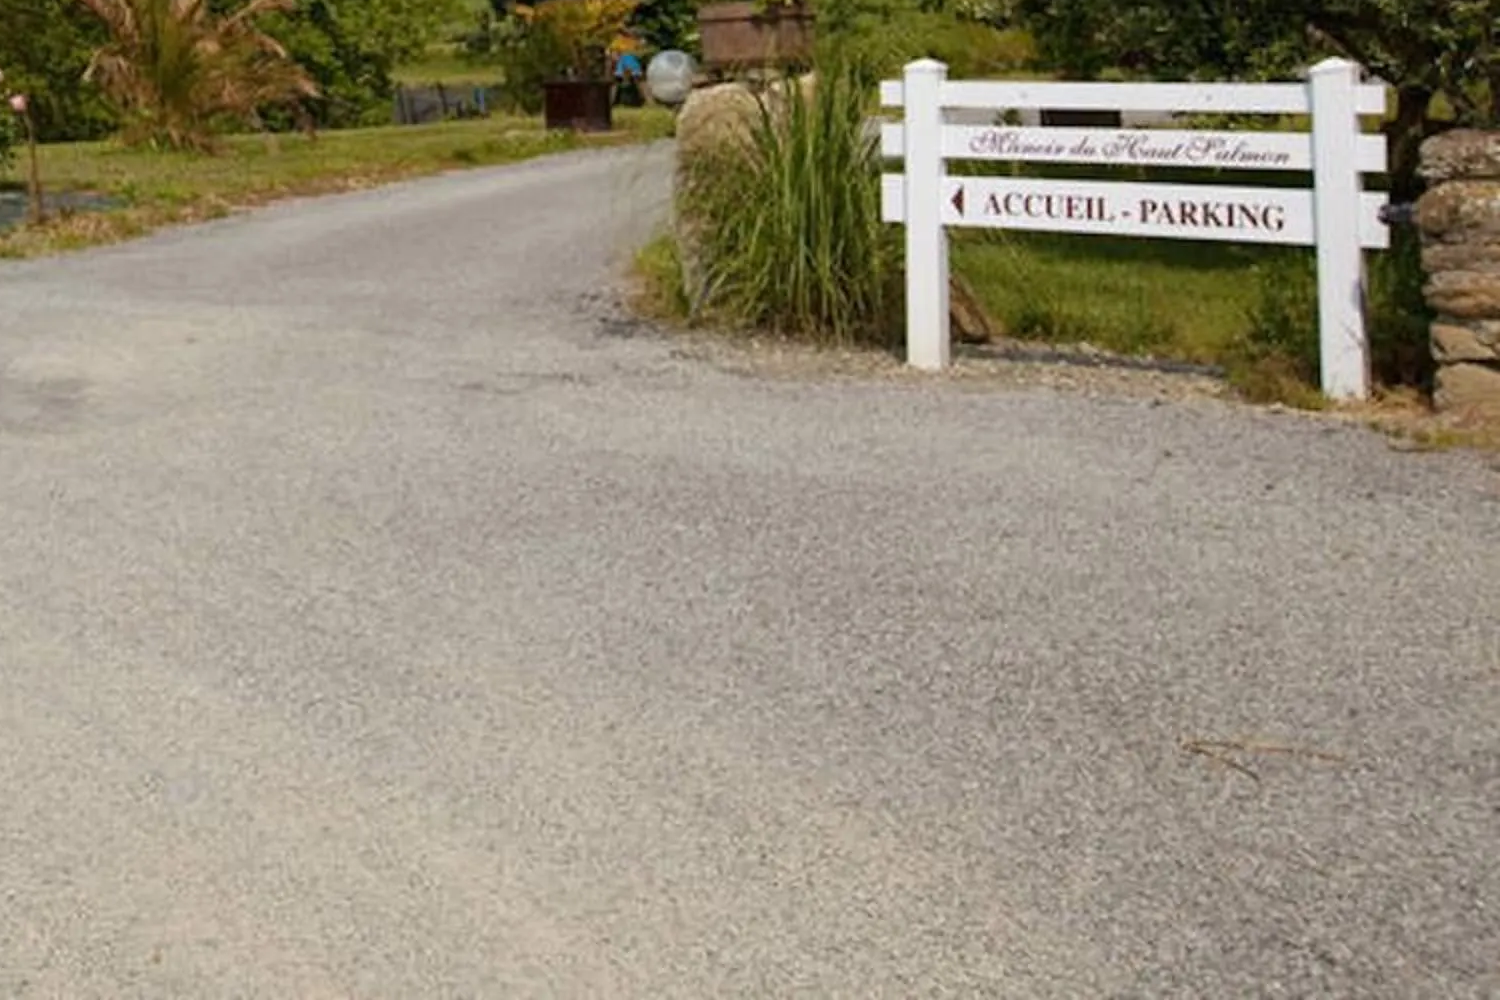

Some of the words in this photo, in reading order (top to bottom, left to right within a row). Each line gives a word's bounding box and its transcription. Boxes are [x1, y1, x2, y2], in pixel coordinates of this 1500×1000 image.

[1068, 135, 1096, 157] du
[984, 191, 1116, 223] ACCUEIL
[1140, 199, 1285, 232] PARKING
